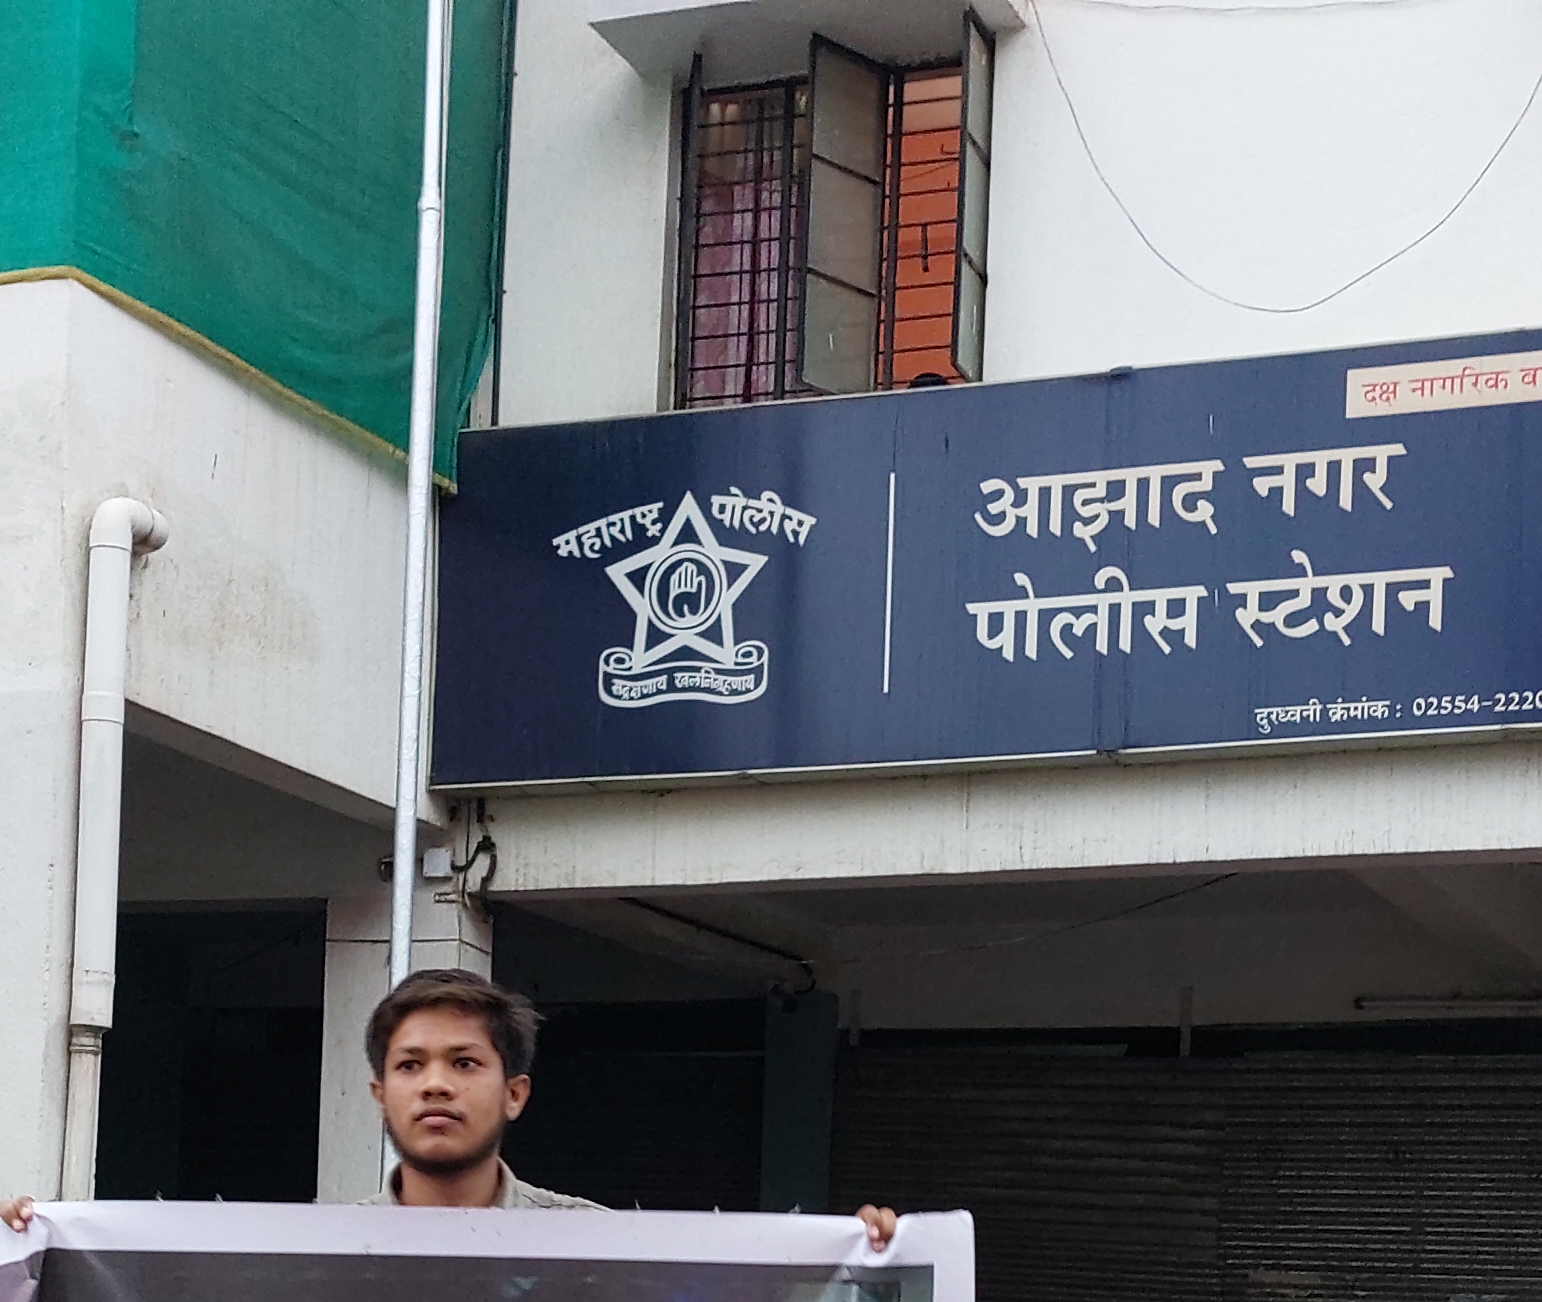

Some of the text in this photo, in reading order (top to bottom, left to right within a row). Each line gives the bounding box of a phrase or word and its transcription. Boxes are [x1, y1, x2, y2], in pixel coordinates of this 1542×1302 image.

[1362, 380, 1400, 408] दक्ष
[1408, 366, 1510, 396] नागरिक
[552, 486, 818, 559] महाराष्ट्र पोलीस
[974, 442, 1408, 553] आझाद नगर
[965, 549, 1455, 663] पोलीस स्टेशन
